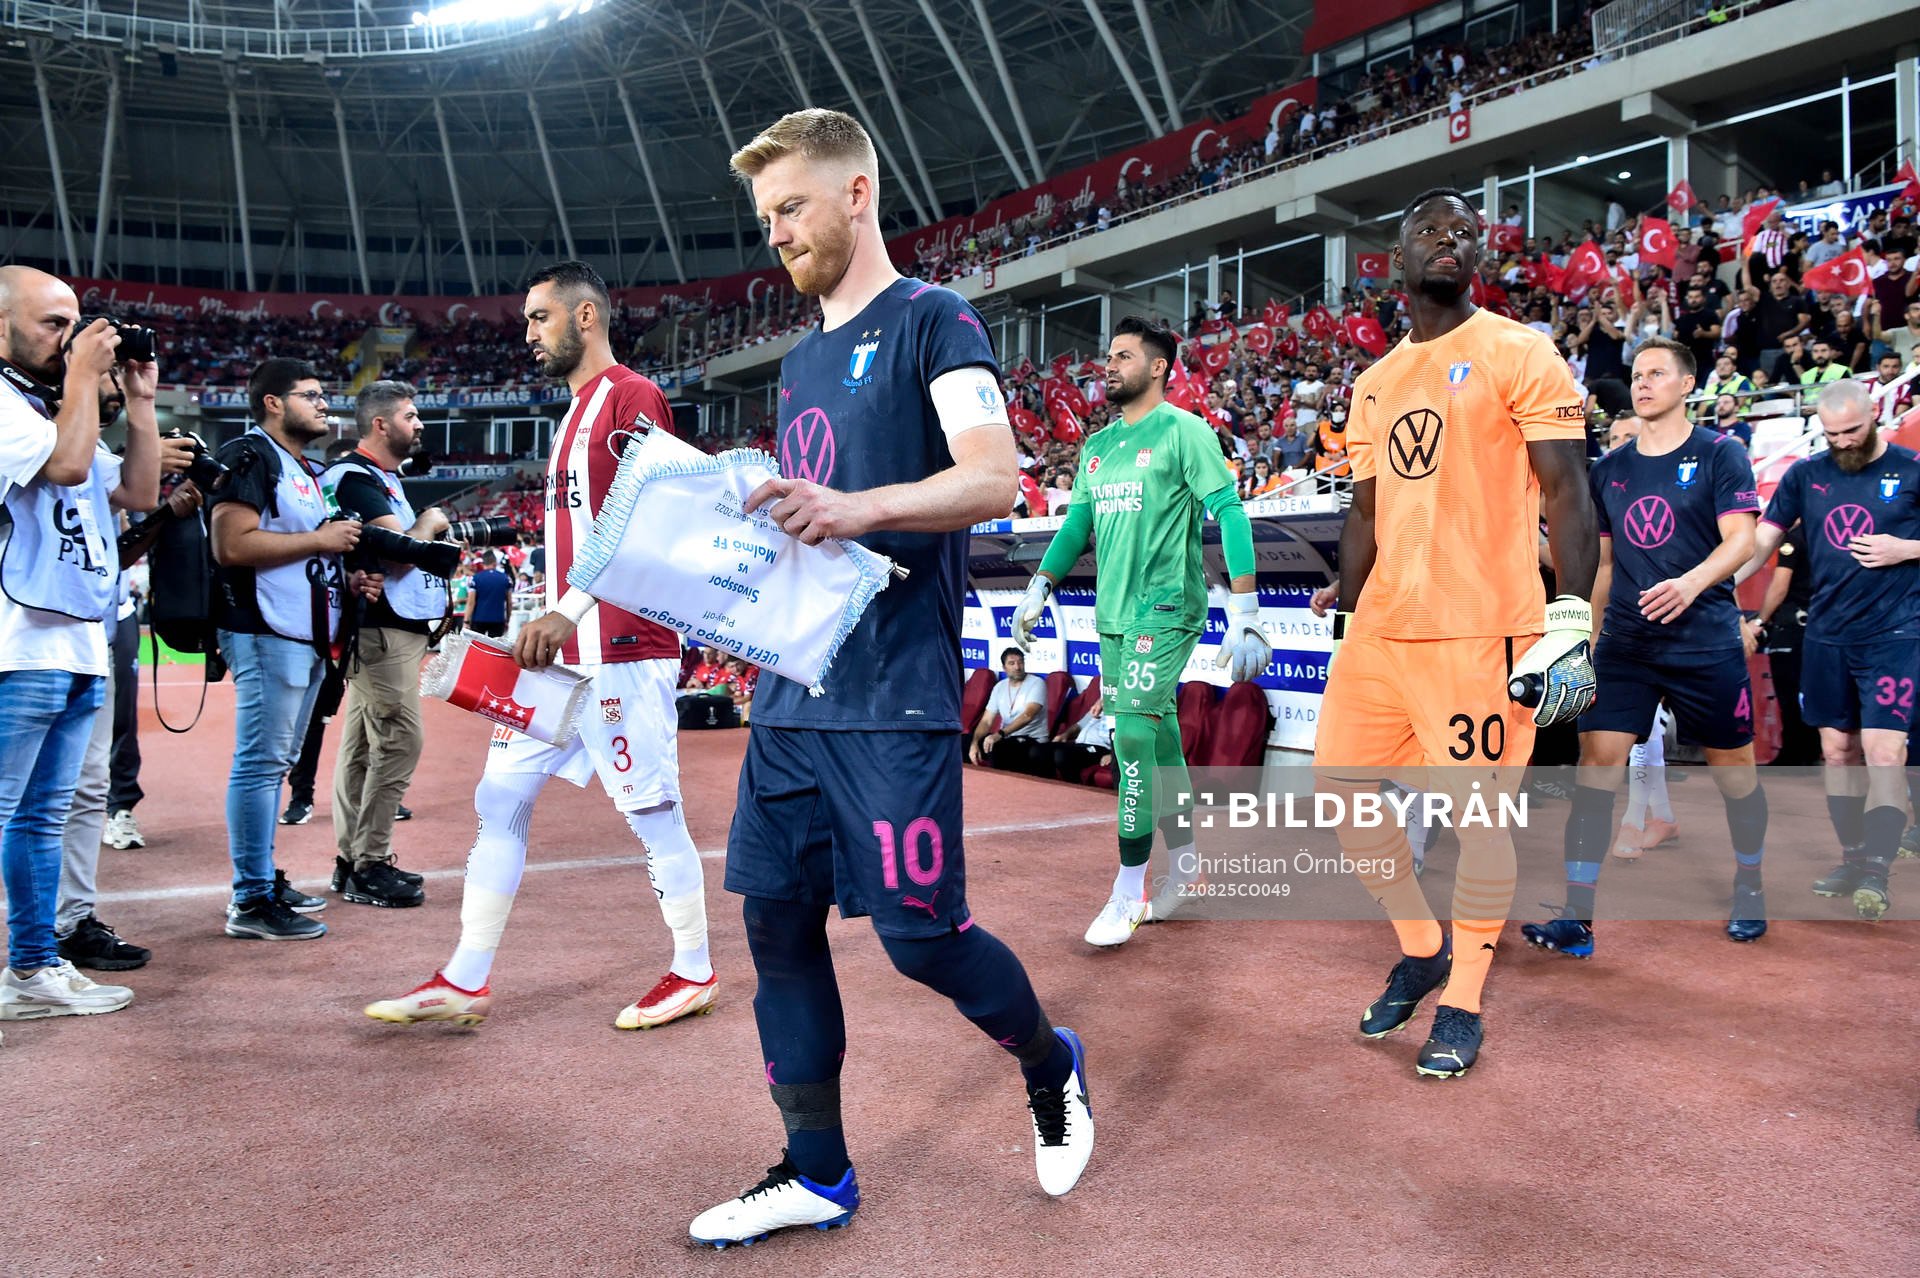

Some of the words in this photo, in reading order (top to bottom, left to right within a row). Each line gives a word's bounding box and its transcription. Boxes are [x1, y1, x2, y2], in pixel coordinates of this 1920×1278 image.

[1451, 114, 1467, 138] C
[984, 270, 994, 287] B
[3, 367, 34, 388] Canon
[1090, 481, 1143, 500] TURKISH
[714, 502, 734, 517] 2022
[760, 521, 768, 529] of
[713, 535, 728, 549] FF
[732, 541, 777, 565] Malmö
[737, 562, 748, 573] vs
[708, 575, 760, 604] Sivasspor
[639, 607, 693, 635] League
[702, 611, 735, 628] Play-off
[1549, 609, 1590, 621] DIAWARA
[697, 628, 743, 654] Europa
[746, 645, 780, 666] UEFA
[1124, 660, 1157, 692] 35
[1734, 687, 1750, 721] 4
[1875, 676, 1914, 708] 32
[1448, 713, 1505, 762] 30
[611, 736, 632, 773] 3
[1123, 778, 1144, 833] bitexen
[873, 816, 945, 889] 10
